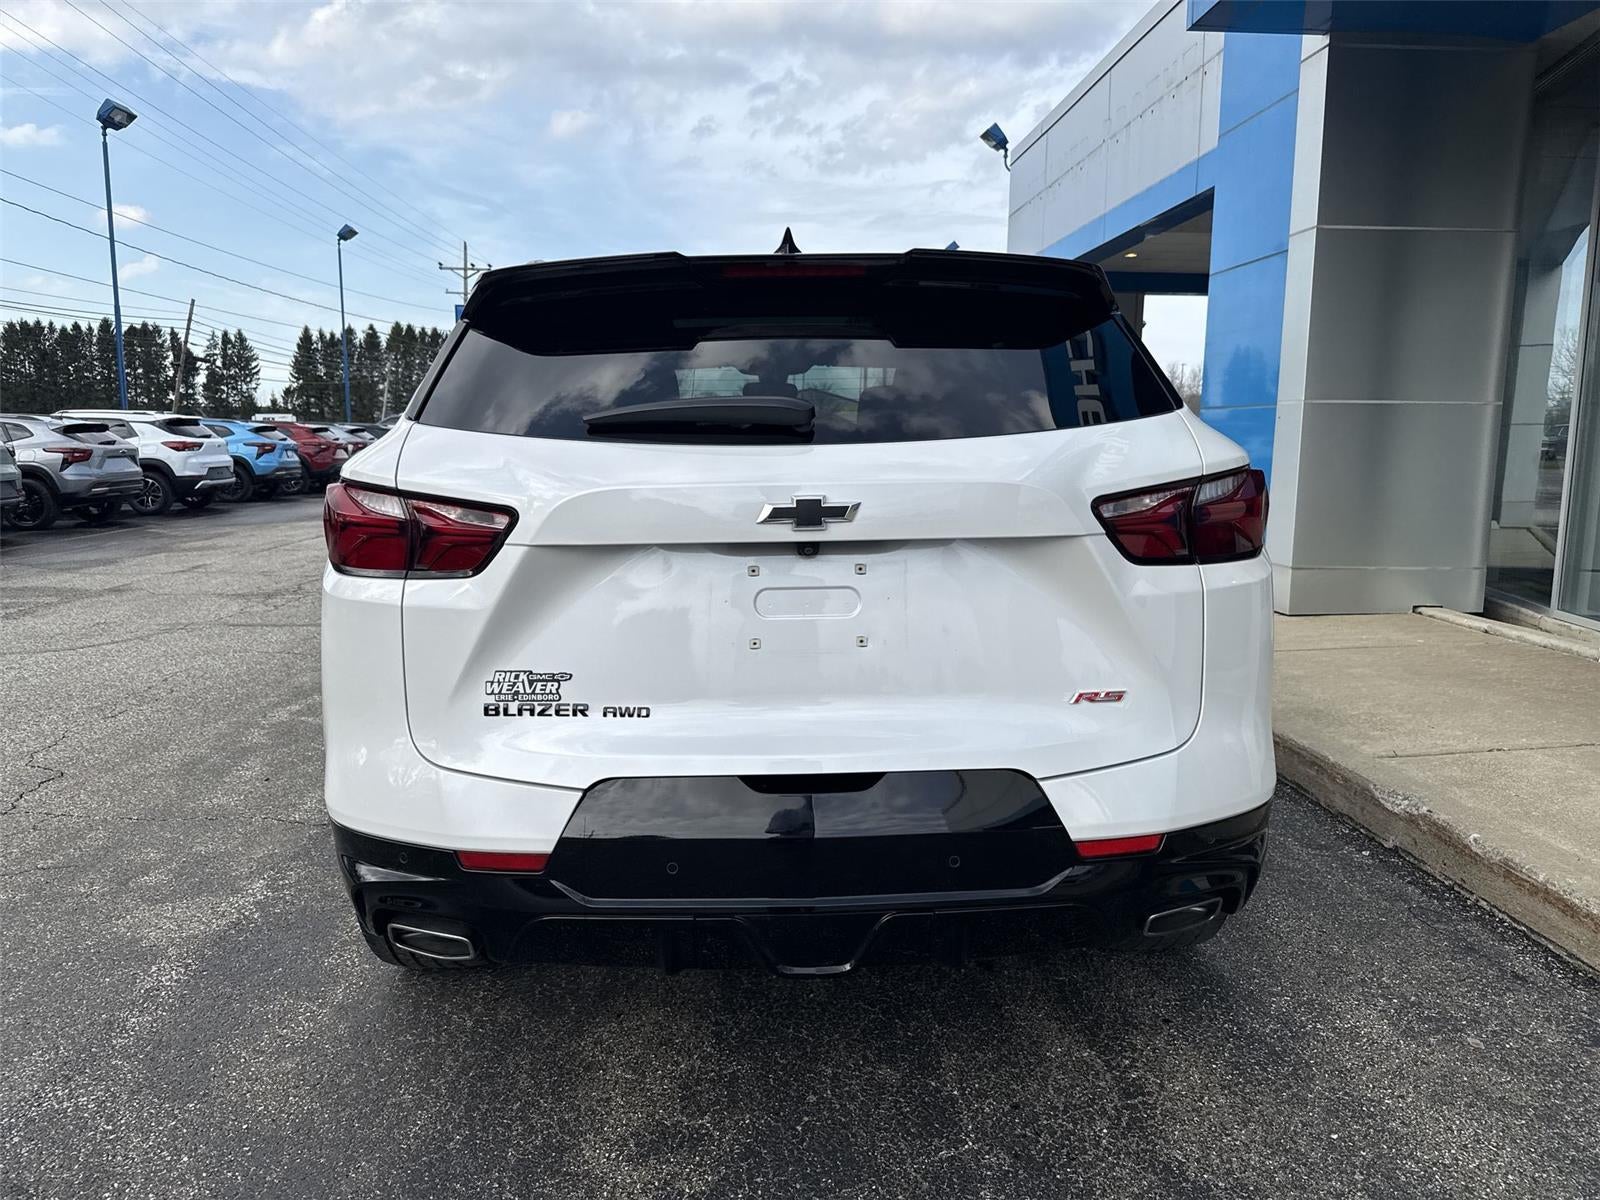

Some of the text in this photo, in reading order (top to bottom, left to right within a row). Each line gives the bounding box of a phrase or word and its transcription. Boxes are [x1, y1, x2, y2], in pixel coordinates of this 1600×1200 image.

[493, 671, 529, 682] RICK
[486, 682, 559, 694] WEAVER
[1069, 689, 1127, 704] RS
[484, 703, 651, 718] BLAZER AWD
